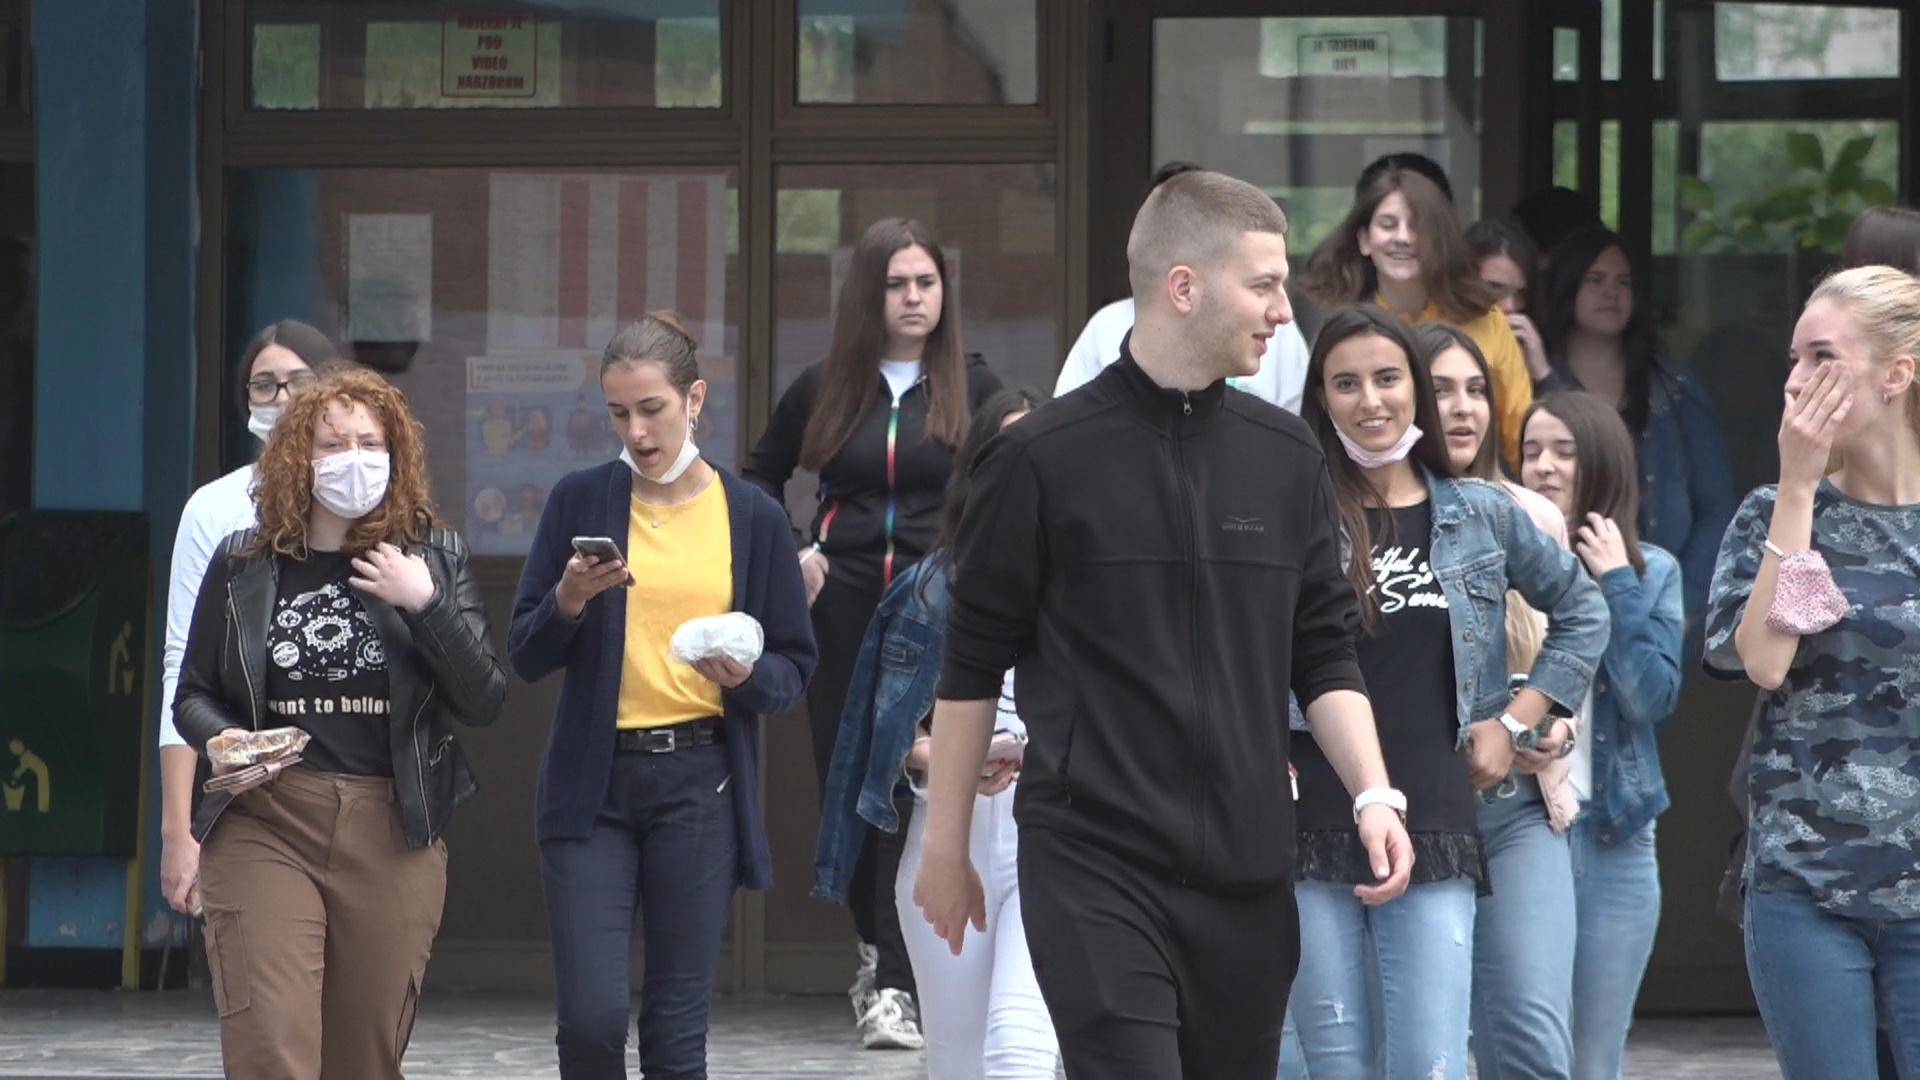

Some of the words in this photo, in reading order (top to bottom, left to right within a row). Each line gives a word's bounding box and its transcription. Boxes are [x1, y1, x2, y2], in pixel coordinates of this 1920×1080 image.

[478, 35, 502, 50] POD
[472, 56, 508, 70] VIDEO
[458, 75, 524, 89] NADZOROM
[314, 697, 334, 714] to
